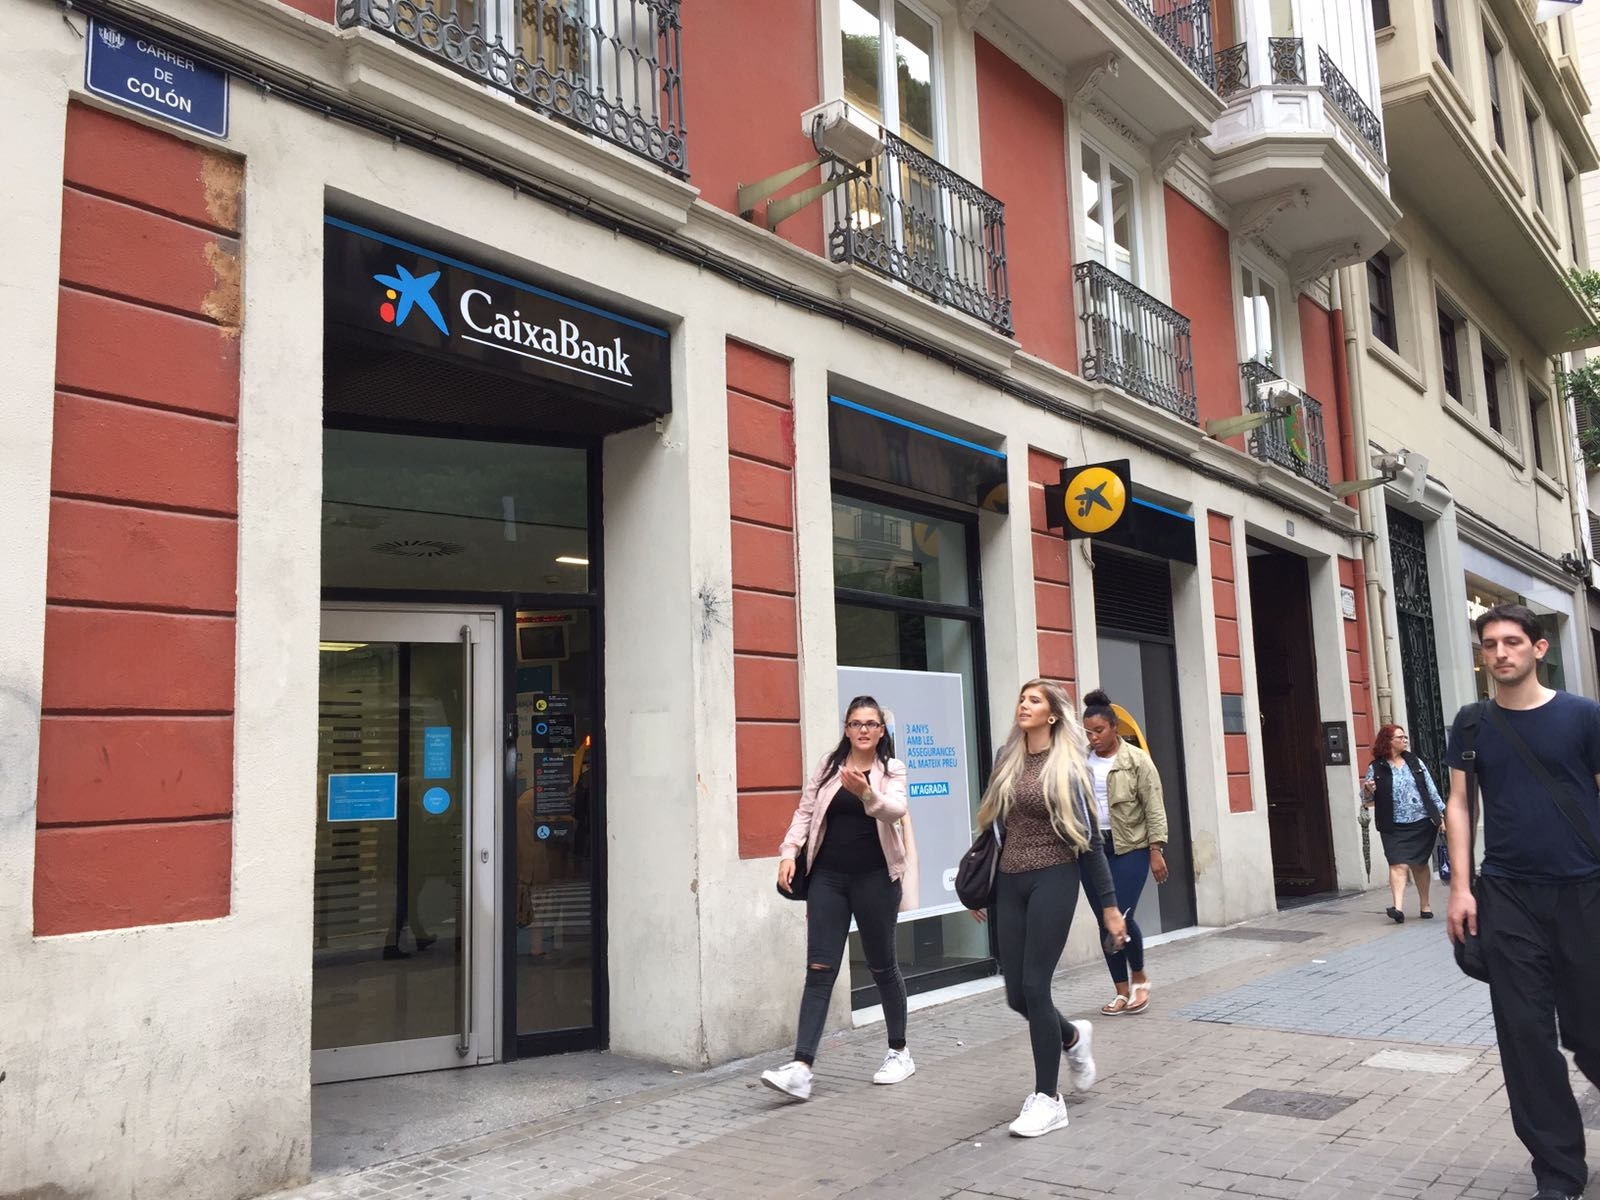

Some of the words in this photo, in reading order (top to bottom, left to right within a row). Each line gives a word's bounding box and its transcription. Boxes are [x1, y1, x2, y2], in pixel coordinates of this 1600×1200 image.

[136, 39, 195, 72] CARRER
[154, 67, 174, 85] DE
[127, 77, 192, 113] COLÓN
[460, 288, 633, 377] CaixaBank
[906, 724, 910, 734] 3
[911, 724, 929, 734] ANYS
[907, 736, 922, 745] AMB
[923, 736, 934, 745] LES
[908, 747, 955, 757] ASSEGURANCES
[908, 759, 917, 769] AL
[918, 758, 941, 768] MATEIX
[942, 758, 958, 768] PREU
[911, 784, 947, 795] M'AGRADA
